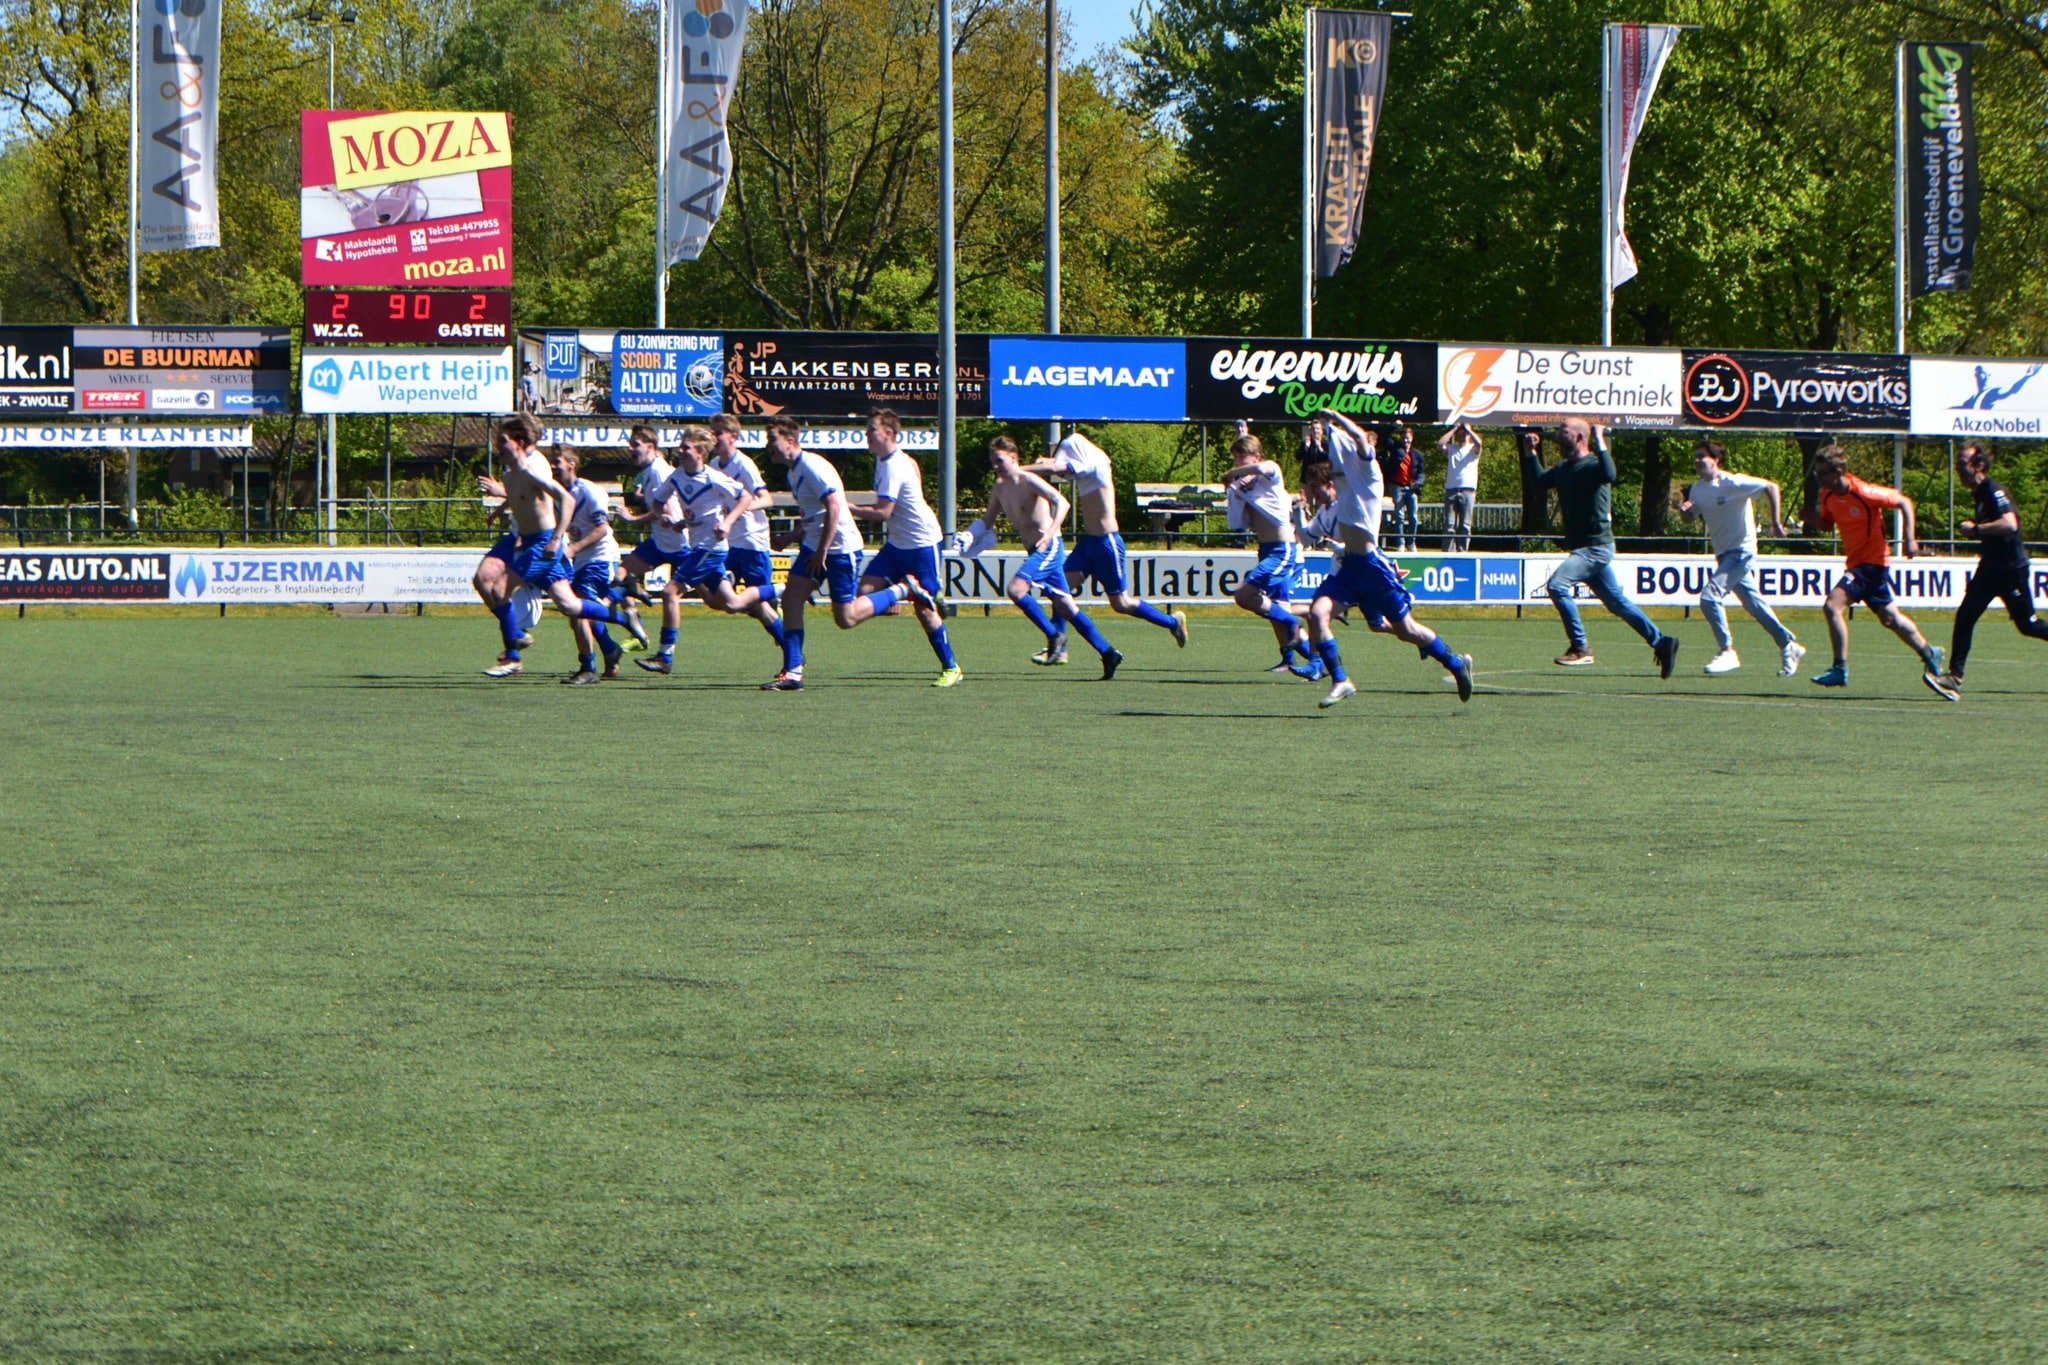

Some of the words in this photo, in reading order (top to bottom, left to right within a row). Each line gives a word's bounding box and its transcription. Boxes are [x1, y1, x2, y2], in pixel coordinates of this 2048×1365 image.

[340, 116, 501, 175] MOZA
[1325, 121, 1349, 245] KRACHT
[1940, 103, 1965, 255] Groeneveld
[1924, 136, 1944, 289] nstallatiebedrijf
[427, 226, 443, 236] Tel:
[444, 218, 499, 234] 038-4479955
[344, 234, 396, 250] Makelaardij
[345, 245, 398, 260] Hypotheken
[404, 247, 505, 280] moza.nl
[332, 294, 350, 320] 2
[469, 294, 487, 320] 2
[151, 330, 215, 343] FIETSEN
[312, 323, 363, 337] W.Z.C.
[438, 323, 506, 337] GASTEN
[620, 335, 636, 350] BIJ
[638, 336, 698, 351] ZONWERING
[700, 336, 720, 350] PUT
[750, 342, 777, 358] JP
[104, 348, 135, 366] DE
[142, 348, 260, 367] BUURMAN
[549, 343, 575, 366] PUT
[620, 352, 662, 368] SCOOR
[664, 353, 677, 370] JE
[1516, 349, 1550, 374] De
[1560, 351, 1633, 376] Gunst
[348, 360, 431, 381] Albert
[441, 360, 509, 386] Heijn
[750, 361, 985, 378] HAKKENBER.NL
[1002, 365, 1174, 388] LAGEMAAT
[1210, 343, 1403, 400] eigenwijs
[109, 374, 152, 384] WINKEL
[620, 372, 677, 394] ALTIJD!
[755, 381, 855, 391] UITVAARTZORG
[865, 382, 872, 391] &
[882, 382, 981, 392] FACILITTEN
[85, 392, 142, 401] TREK
[378, 384, 478, 404] Wapenveld
[866, 392, 910, 402] Wapenveld
[962, 392, 981, 400] 1701
[1513, 380, 1674, 408] Infratechniek
[1753, 372, 1908, 408] Pyroworks
[19, 396, 69, 408] ZWOLLE
[157, 396, 191, 404] Gazelle
[225, 395, 280, 404] KOGA
[1625, 415, 1674, 426] Wapenveld
[1952, 416, 2041, 433] AkzoNobel
[40, 426, 107, 442] ONZE
[120, 426, 244, 442] KLANTEN!
[596, 426, 609, 442] U
[828, 429, 937, 444] SPOORS?
[47, 558, 167, 581] AUTO.NL
[212, 561, 365, 582] IJZERMAN
[1483, 573, 1517, 586] NHM
[1887, 569, 1952, 597] NHM
[16, 584, 73, 595] verkoop
[211, 584, 272, 596] Loodgieters-
[274, 584, 282, 594] &
[285, 584, 366, 596] Installatiebedrijf
